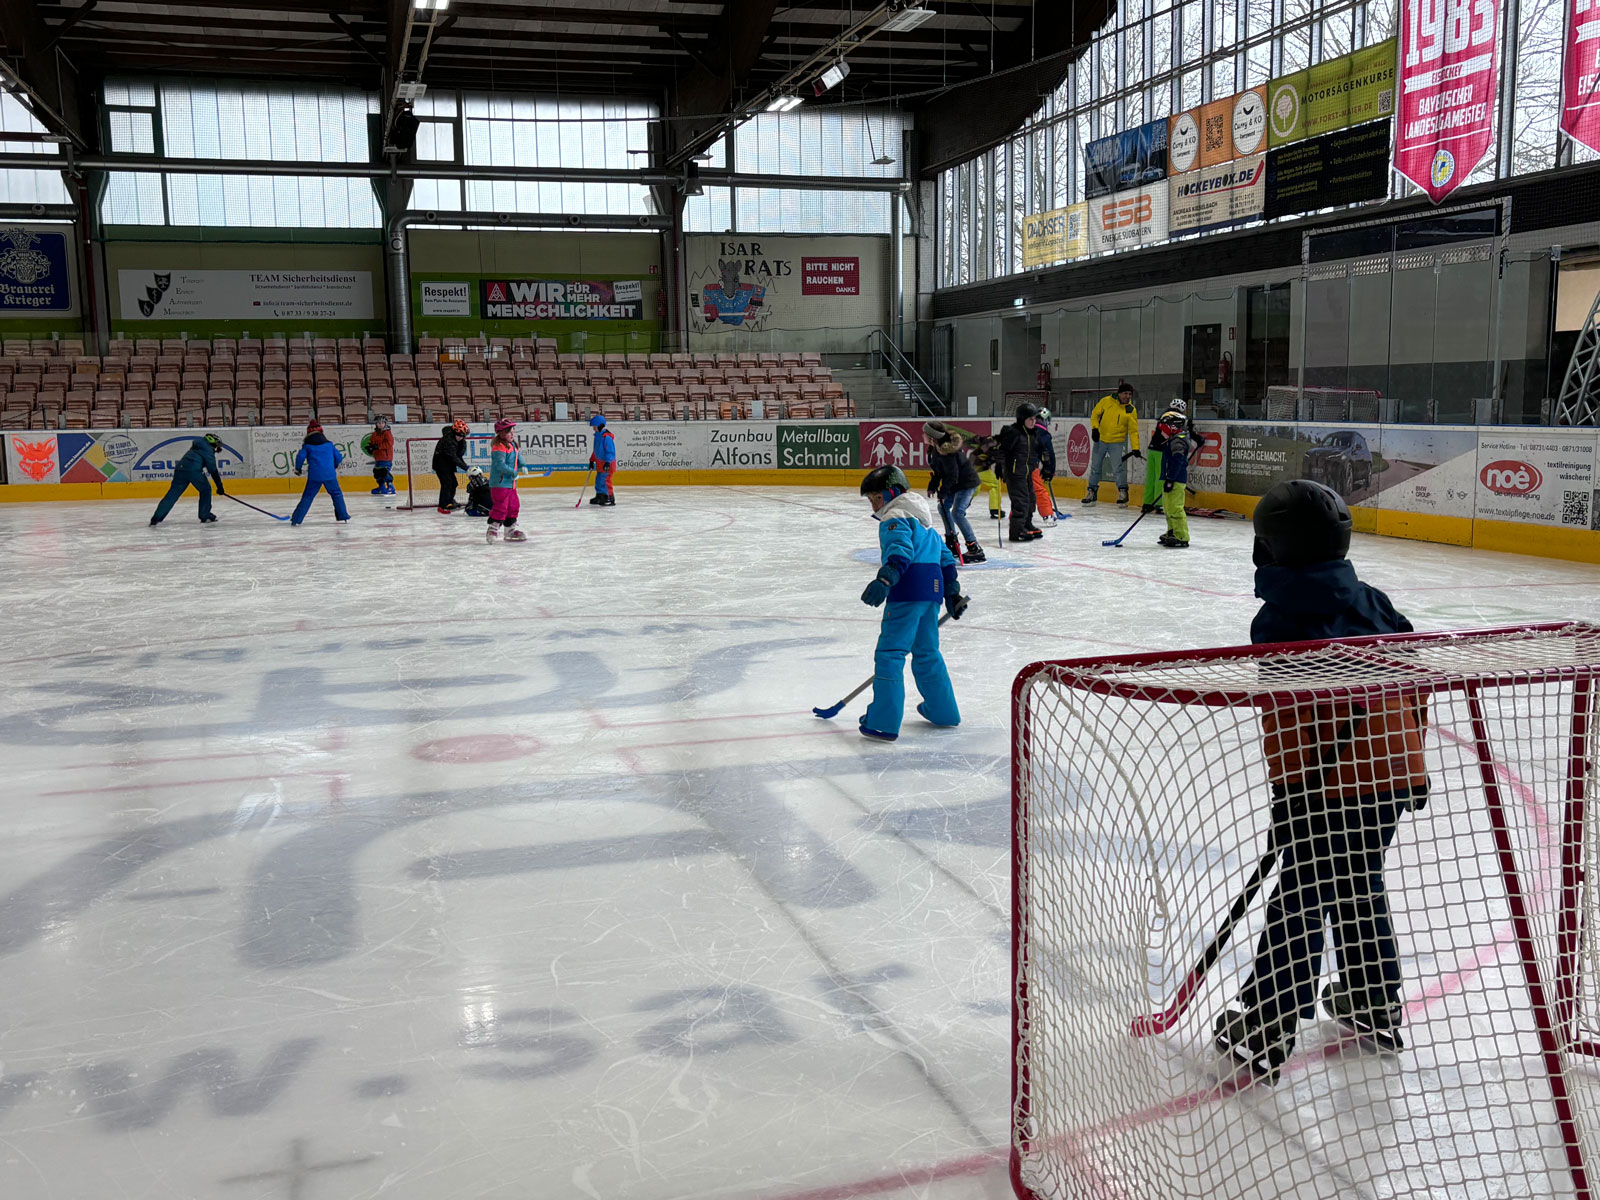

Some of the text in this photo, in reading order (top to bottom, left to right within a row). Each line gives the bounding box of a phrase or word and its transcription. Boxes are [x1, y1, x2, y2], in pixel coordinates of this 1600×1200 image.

[1301, 68, 1394, 106] MOTORSÄGENKURSE
[1177, 168, 1254, 198] HOCKEYBOX.DE
[1102, 194, 1152, 230] ESB
[720, 242, 763, 255] ISAR
[744, 260, 791, 276] RATS
[806, 263, 855, 271] BITTE NICHT
[249, 274, 356, 283] TEAM Sicherheitsdienst
[806, 277, 844, 285] RAUCHEN
[0, 284, 55, 294] Brauerei
[424, 286, 467, 298] Respekt!
[509, 282, 590, 303] WIR FÜR
[4, 294, 51, 307] Krieger
[567, 293, 601, 303] MEHR
[487, 304, 636, 318] MENSCHLICHKEIT
[517, 434, 587, 449] HARRER
[710, 428, 773, 443] Zaunbau
[781, 428, 850, 443] Metallbau
[1231, 437, 1258, 448] ZUKUNFT
[1481, 442, 1499, 450] Service
[554, 447, 587, 456] GmbH
[711, 447, 772, 466] Alfons
[783, 447, 850, 466] Schmid
[657, 458, 692, 467] Vordächer
[1547, 461, 1591, 471] textilreinigung
[1188, 472, 1223, 486] DBAYERN
[1559, 473, 1591, 481] wäscherei
